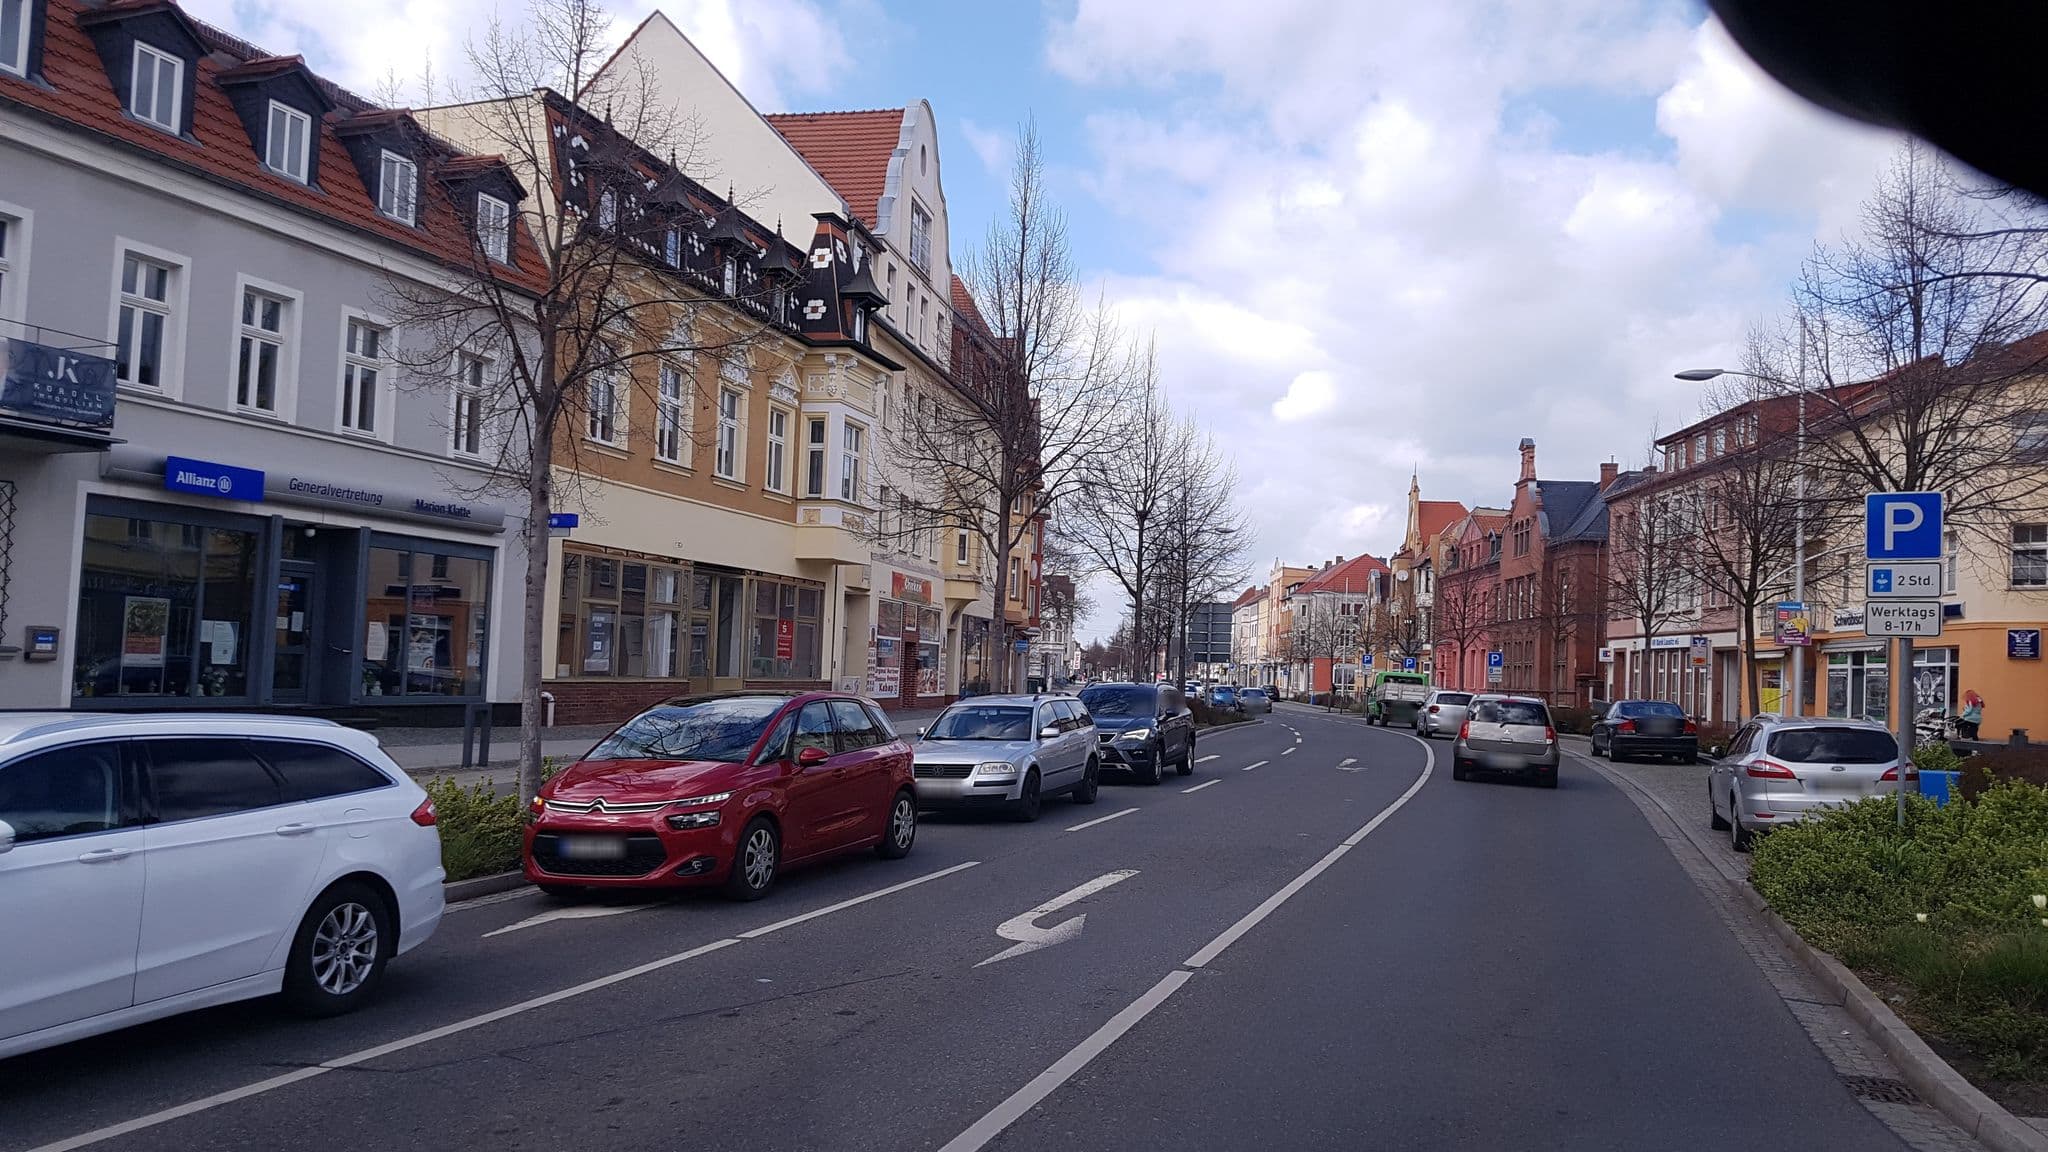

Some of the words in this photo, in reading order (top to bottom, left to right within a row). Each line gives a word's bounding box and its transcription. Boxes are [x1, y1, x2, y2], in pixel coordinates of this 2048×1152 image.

[176, 471, 216, 488] Allianz
[289, 477, 383, 505] Generalvertretung
[415, 499, 445, 514] Marion
[1884, 502, 1924, 551] P
[1898, 576, 1905, 586] 2
[1909, 575, 1934, 586] Std.
[1871, 606, 1936, 620] Werktags
[1406, 659, 1412, 667] P
[1491, 654, 1500, 664] P
